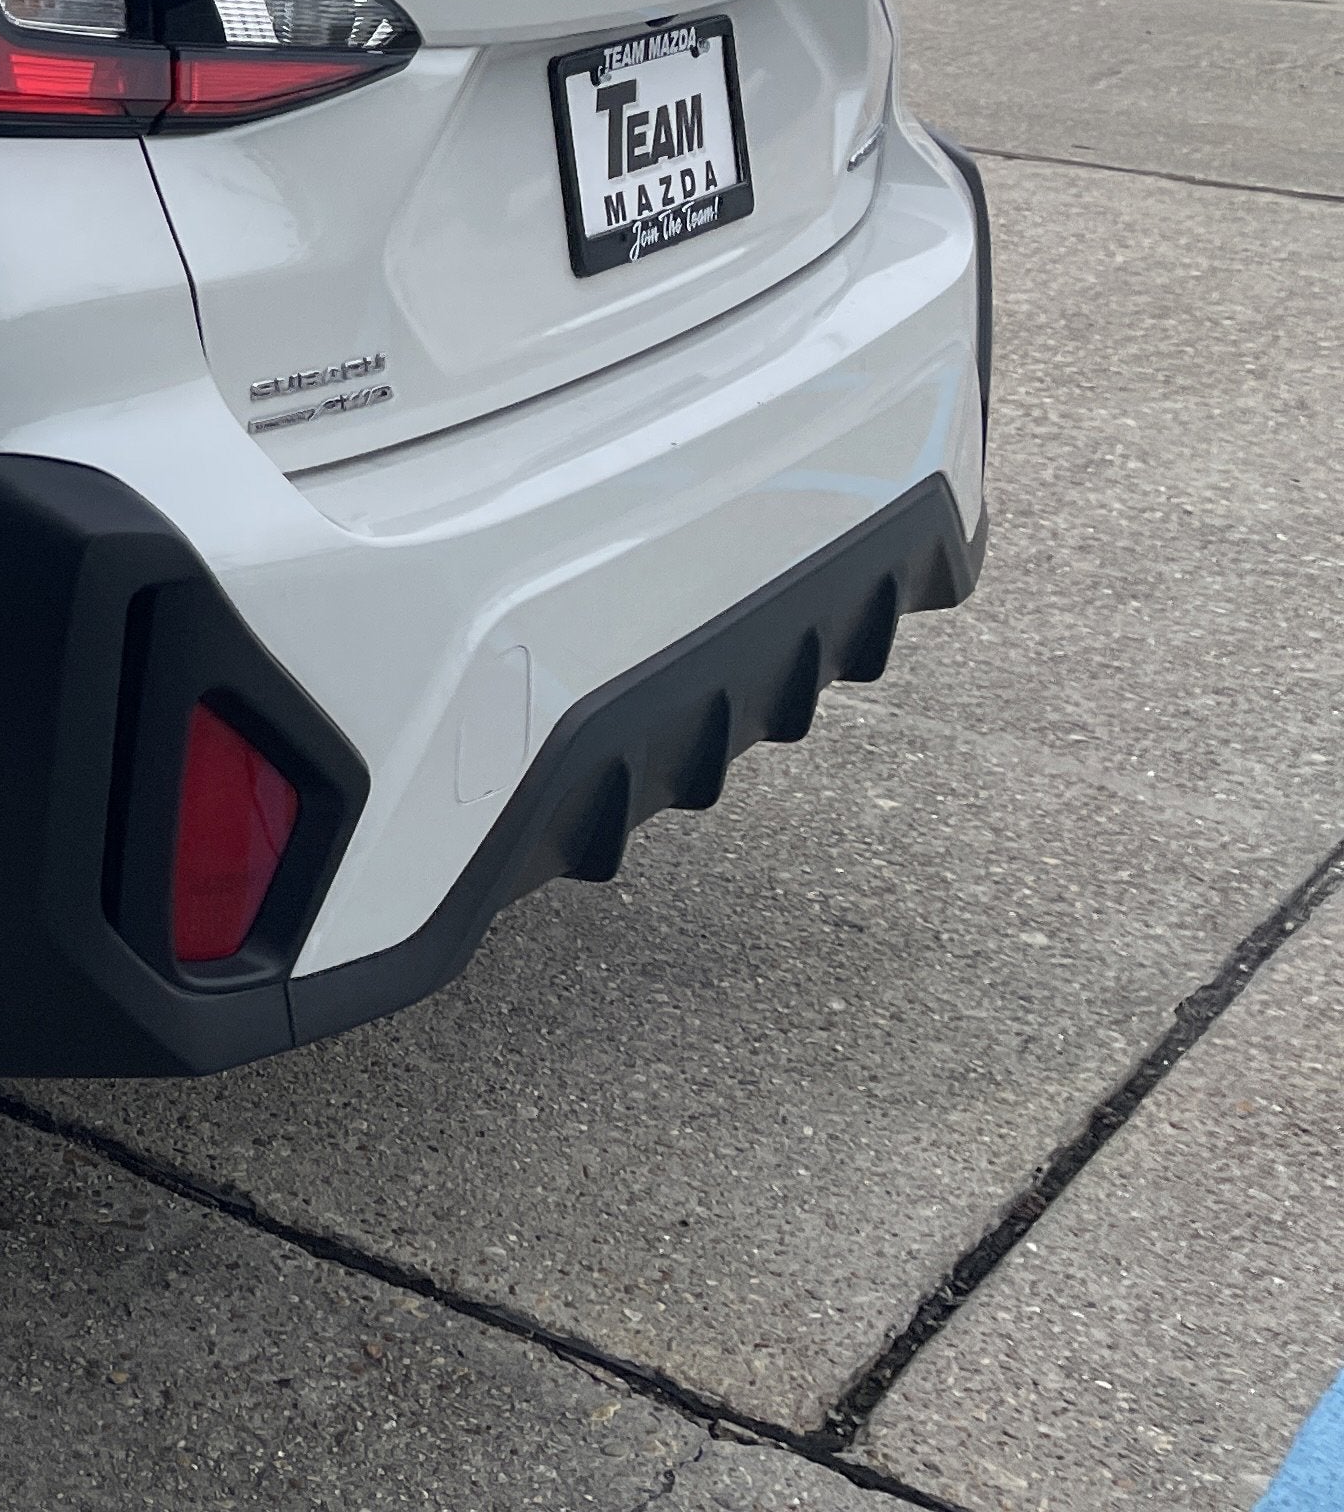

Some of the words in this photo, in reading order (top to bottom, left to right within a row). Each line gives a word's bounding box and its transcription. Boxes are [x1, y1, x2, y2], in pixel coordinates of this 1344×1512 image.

[604, 39, 645, 70] TEAM
[649, 27, 697, 60] MAZDA
[596, 79, 703, 180] TEAM
[604, 160, 718, 226] MAZDA
[629, 221, 660, 261] Join
[658, 209, 683, 240] The
[682, 196, 719, 231] Team!
[250, 352, 388, 400] SUBARU
